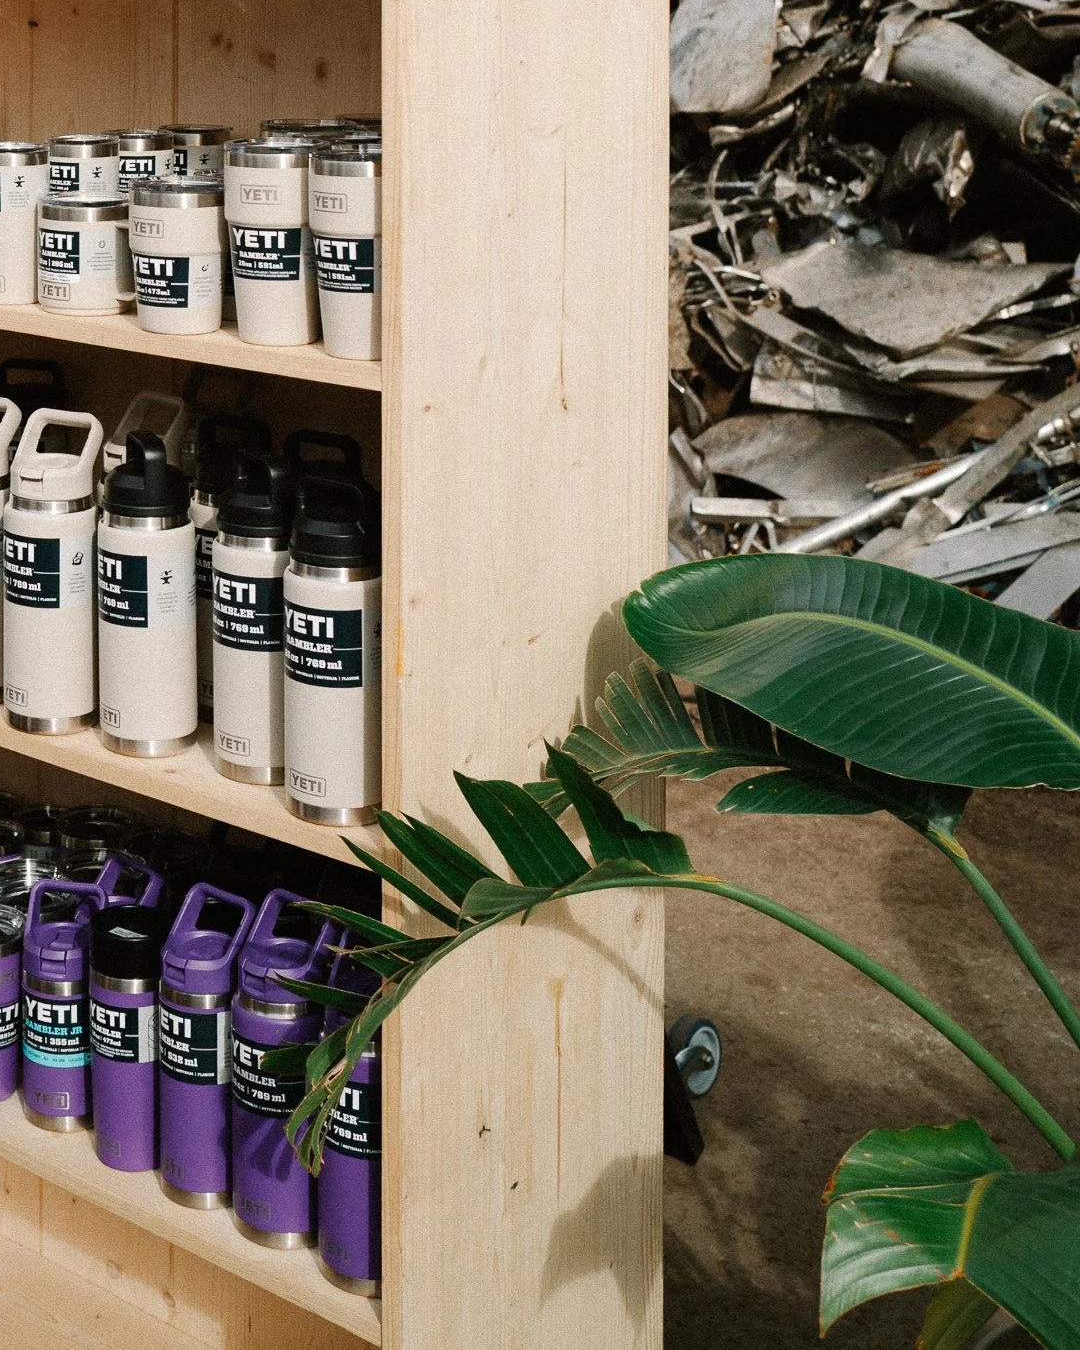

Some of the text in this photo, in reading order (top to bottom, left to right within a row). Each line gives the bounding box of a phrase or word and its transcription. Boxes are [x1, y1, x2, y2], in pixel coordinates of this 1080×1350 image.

[243, 188, 278, 202] YETI
[315, 194, 343, 209] YETI
[134, 220, 160, 234] YETI
[39, 231, 74, 250] YETI
[232, 228, 285, 249] YETI
[313, 237, 356, 260] YETI
[133, 255, 174, 277] YETI
[42, 284, 66, 298] YETI
[285, 605, 334, 638] YETI
[219, 734, 246, 753] YETI
[292, 772, 323, 794] YETI
[26, 996, 77, 1024] YETI
[25, 1018, 82, 1035] RAMBLER JR
[161, 1009, 191, 1038] ETI
